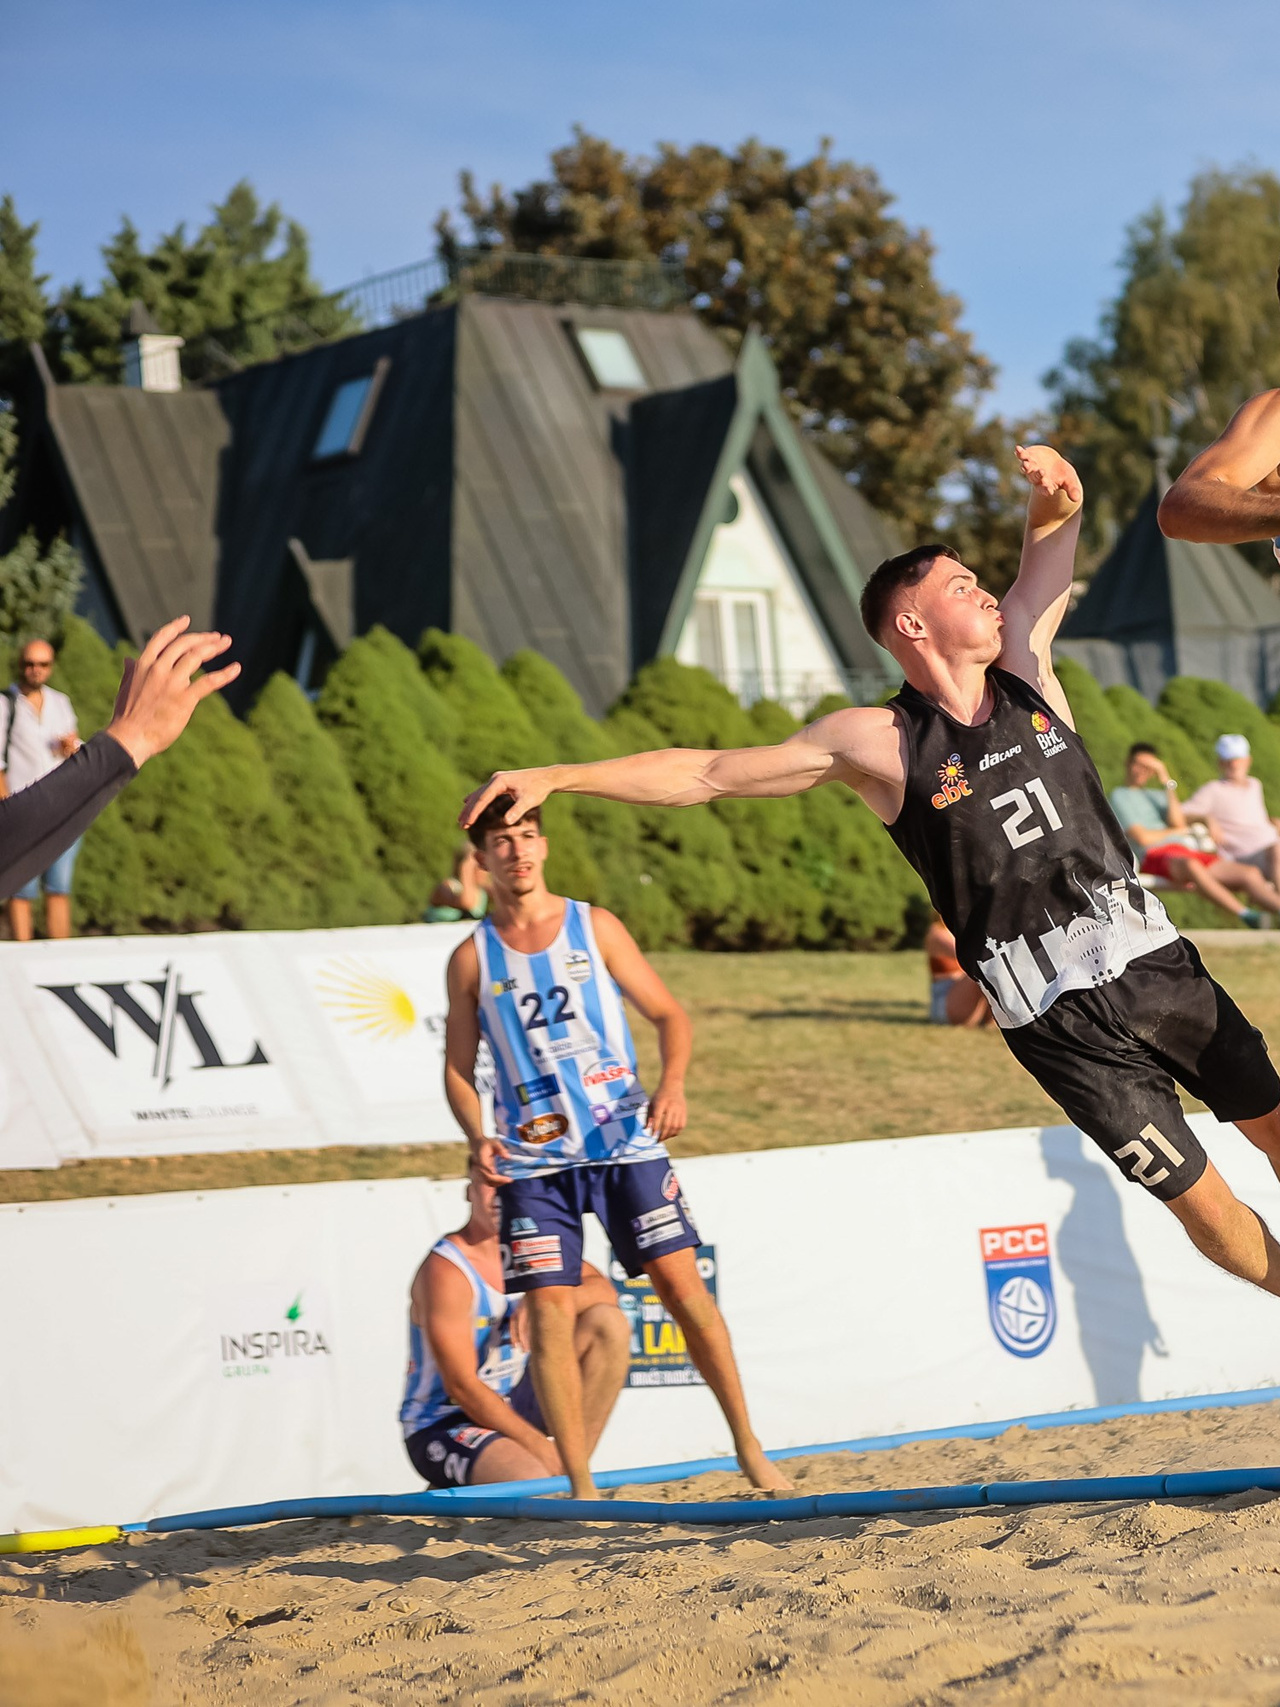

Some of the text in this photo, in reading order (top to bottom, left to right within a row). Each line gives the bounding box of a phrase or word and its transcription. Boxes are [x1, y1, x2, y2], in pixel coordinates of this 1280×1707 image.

[1035, 726, 1063, 751] BHC
[1043, 740, 1068, 759] student
[931, 778, 974, 810] ebt
[989, 776, 1064, 850] 21
[520, 985, 577, 1031] 22
[1113, 1121, 1186, 1187] 21
[982, 1227, 1046, 1256] PCC
[220, 1329, 331, 1361] INSPIRA
